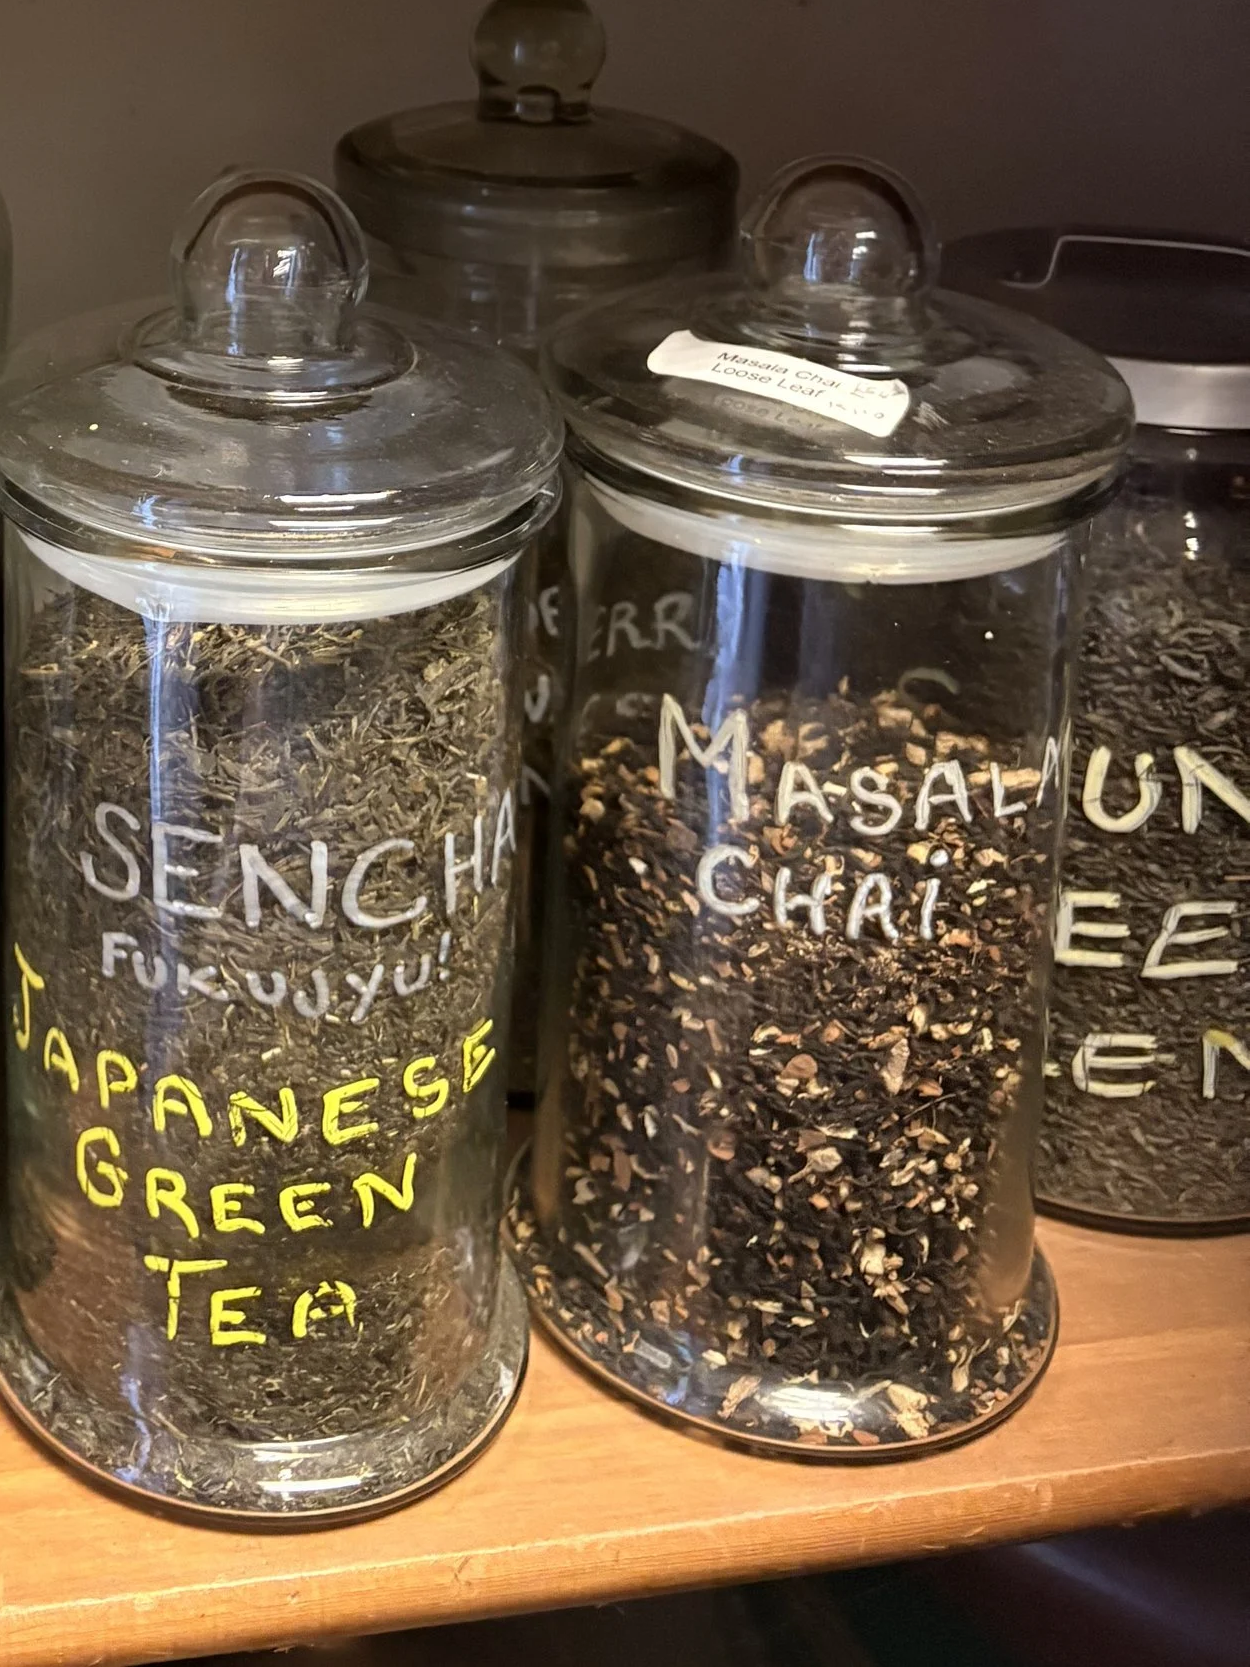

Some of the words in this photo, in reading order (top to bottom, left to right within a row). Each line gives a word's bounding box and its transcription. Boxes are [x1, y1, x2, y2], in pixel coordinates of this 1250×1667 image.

[711, 362, 772, 385] Loose
[776, 377, 827, 399] Leaf
[716, 351, 790, 376] Masala
[795, 370, 843, 389] Chai
[657, 692, 1061, 836] MASALA
[78, 786, 517, 930] SENCHA
[13, 940, 498, 1147] JAPANESE
[75, 1125, 417, 1239] GREEN
[143, 1254, 359, 1347] TEA
